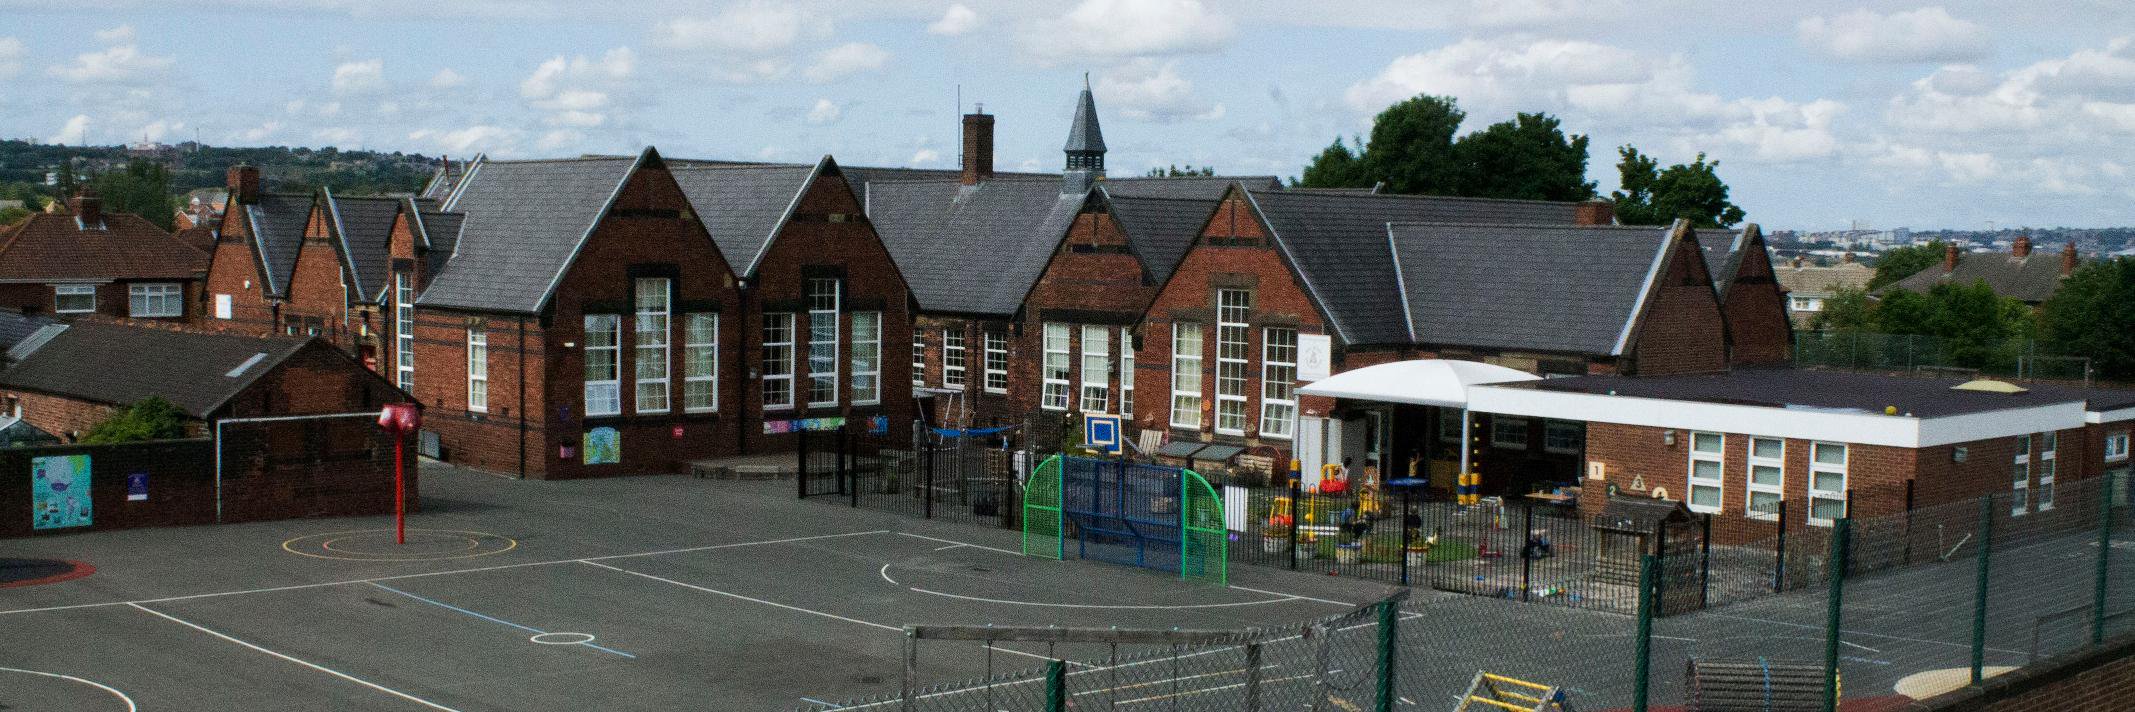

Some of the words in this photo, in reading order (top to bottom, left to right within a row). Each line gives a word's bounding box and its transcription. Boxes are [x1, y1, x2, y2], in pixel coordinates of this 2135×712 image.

[1594, 465, 1599, 475] 1
[1635, 478, 1642, 488] 3
[1609, 485, 1616, 496] 2
